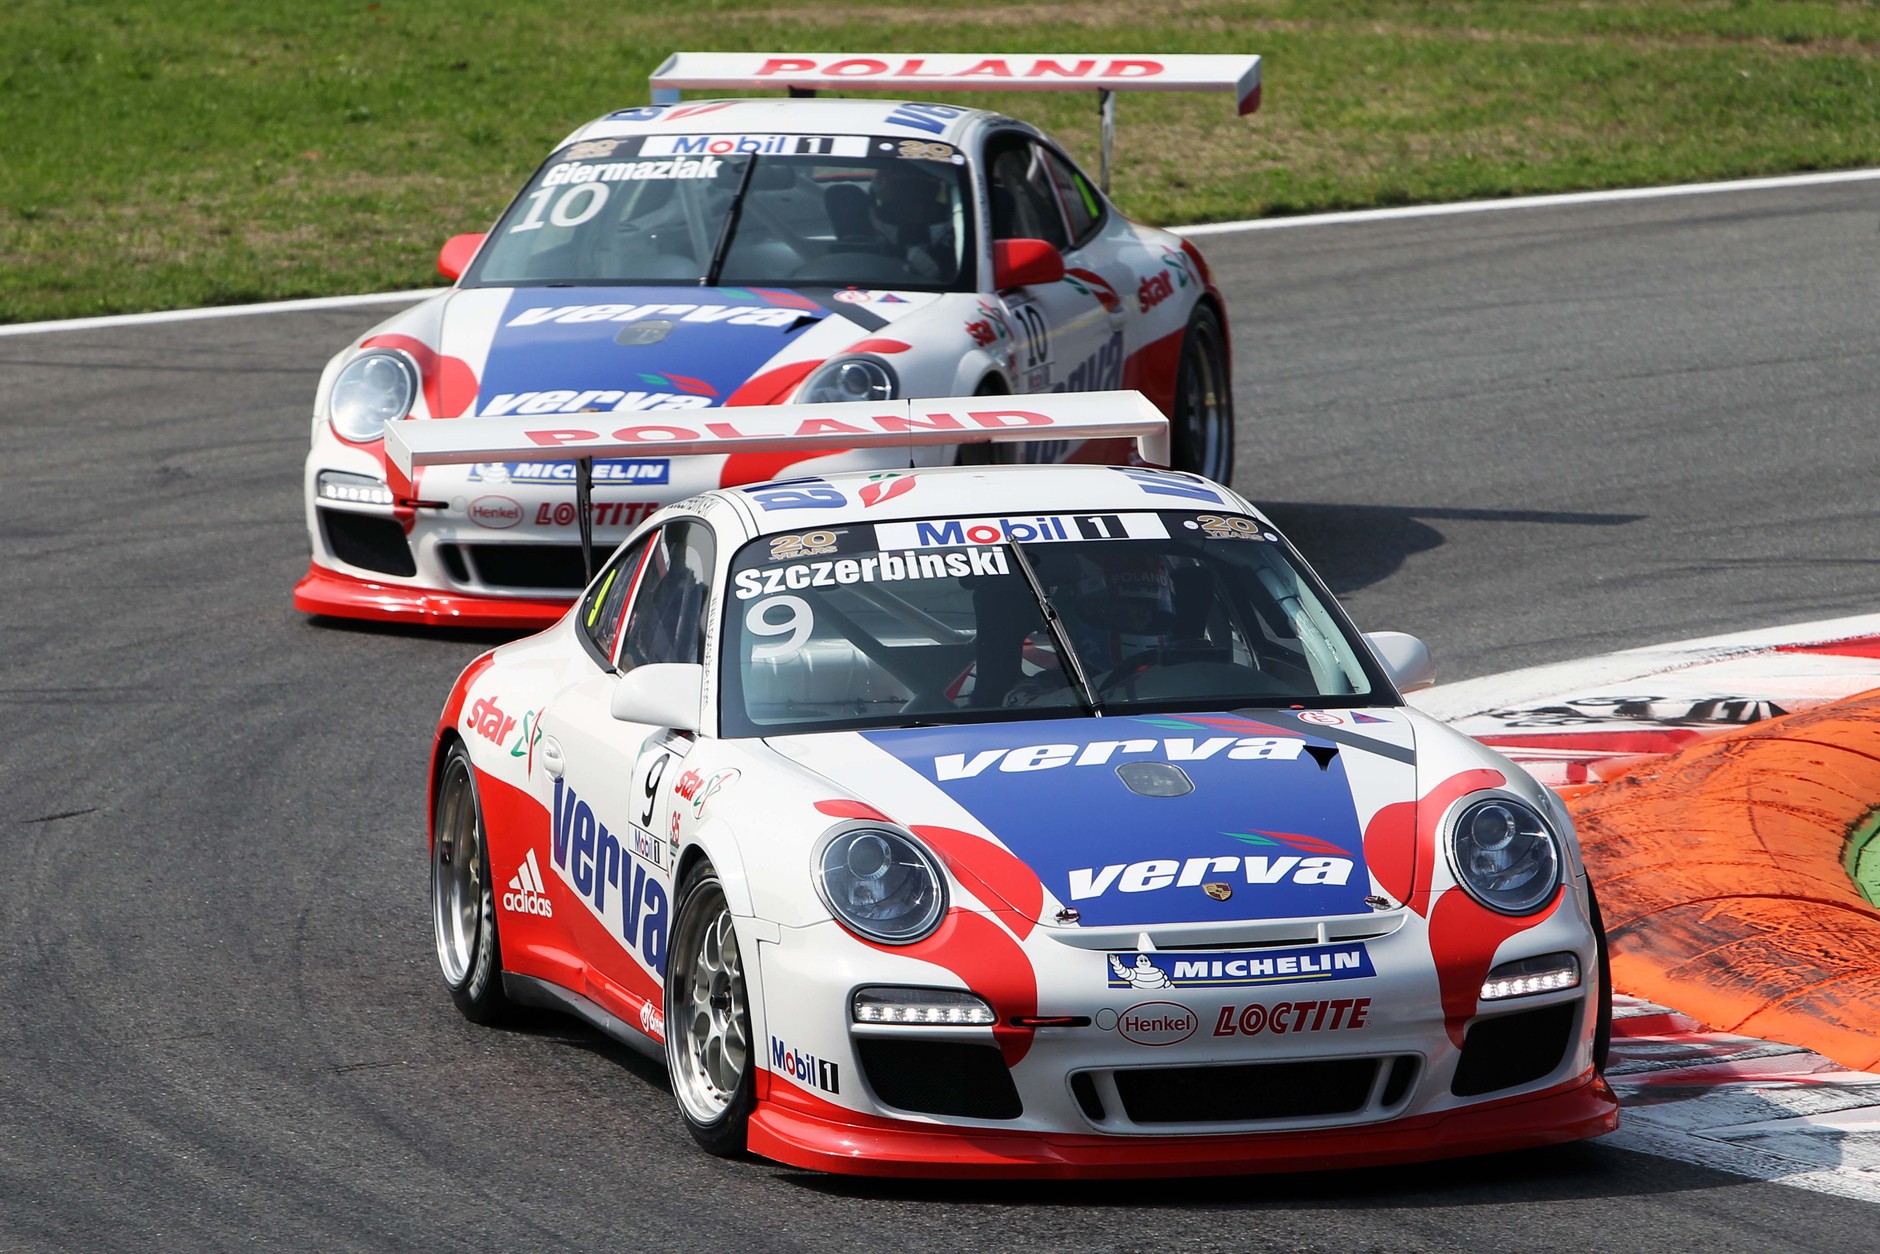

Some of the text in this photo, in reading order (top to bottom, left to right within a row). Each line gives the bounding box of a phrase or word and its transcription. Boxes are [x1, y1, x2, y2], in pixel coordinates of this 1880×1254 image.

[754, 57, 1165, 77] POLAND
[671, 135, 787, 155] Mobil
[541, 156, 723, 187] Giermaziak
[510, 182, 609, 234] 10
[1137, 268, 1175, 314] star
[505, 303, 812, 328] verva
[1014, 304, 1048, 367] 10
[524, 410, 1055, 447] POLAND
[513, 461, 666, 479] MICELIN
[473, 506, 519, 519] Henkel
[535, 501, 660, 526] LOTITE
[1196, 514, 1259, 534] 20
[769, 530, 837, 555] 20
[916, 516, 1111, 546] Mobil 1
[734, 547, 1010, 600] Szczerbinski
[745, 595, 814, 664] 9
[466, 696, 517, 747] star
[933, 736, 1307, 782] verva
[641, 753, 671, 828] 9
[674, 768, 705, 801] star
[634, 828, 654, 861] Mobil
[553, 777, 668, 979] verva
[1068, 855, 1354, 901] verva
[502, 889, 552, 918] adidas
[1173, 950, 1361, 978] MICHELIN
[1124, 1014, 1193, 1032] Henkel
[1212, 997, 1372, 1037] LOCTITE
[771, 1035, 817, 1087] Mobil
